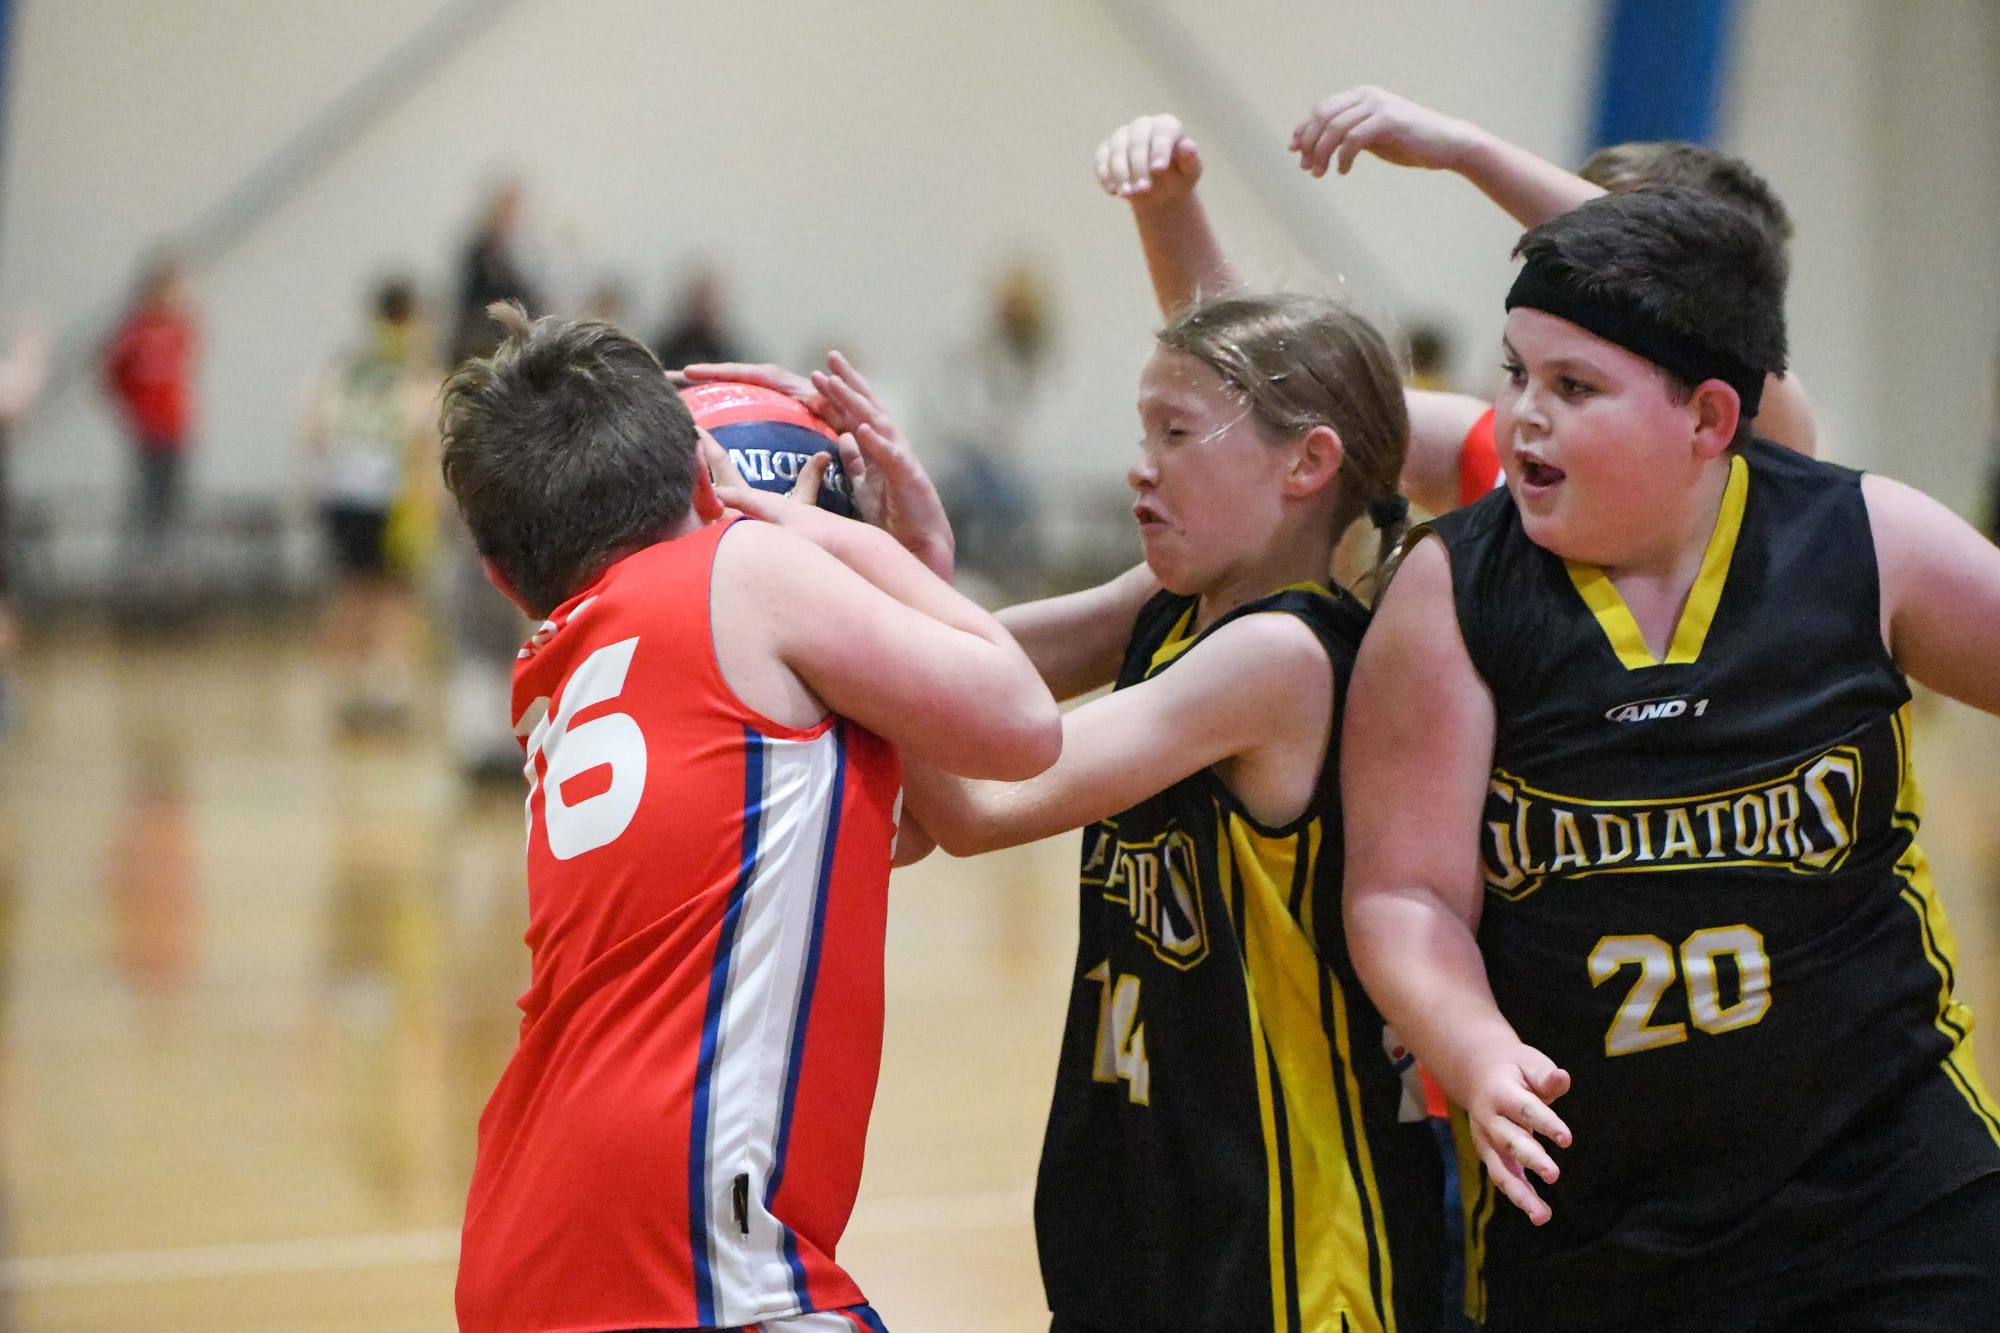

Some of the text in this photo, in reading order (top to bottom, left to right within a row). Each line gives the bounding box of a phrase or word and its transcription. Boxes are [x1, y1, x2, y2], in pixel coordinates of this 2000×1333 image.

[1617, 699, 1709, 722] AND 1
[1485, 755, 1855, 890] GLADIATORS
[1084, 959, 1149, 1108] 14
[1587, 923, 1772, 1057] 20
